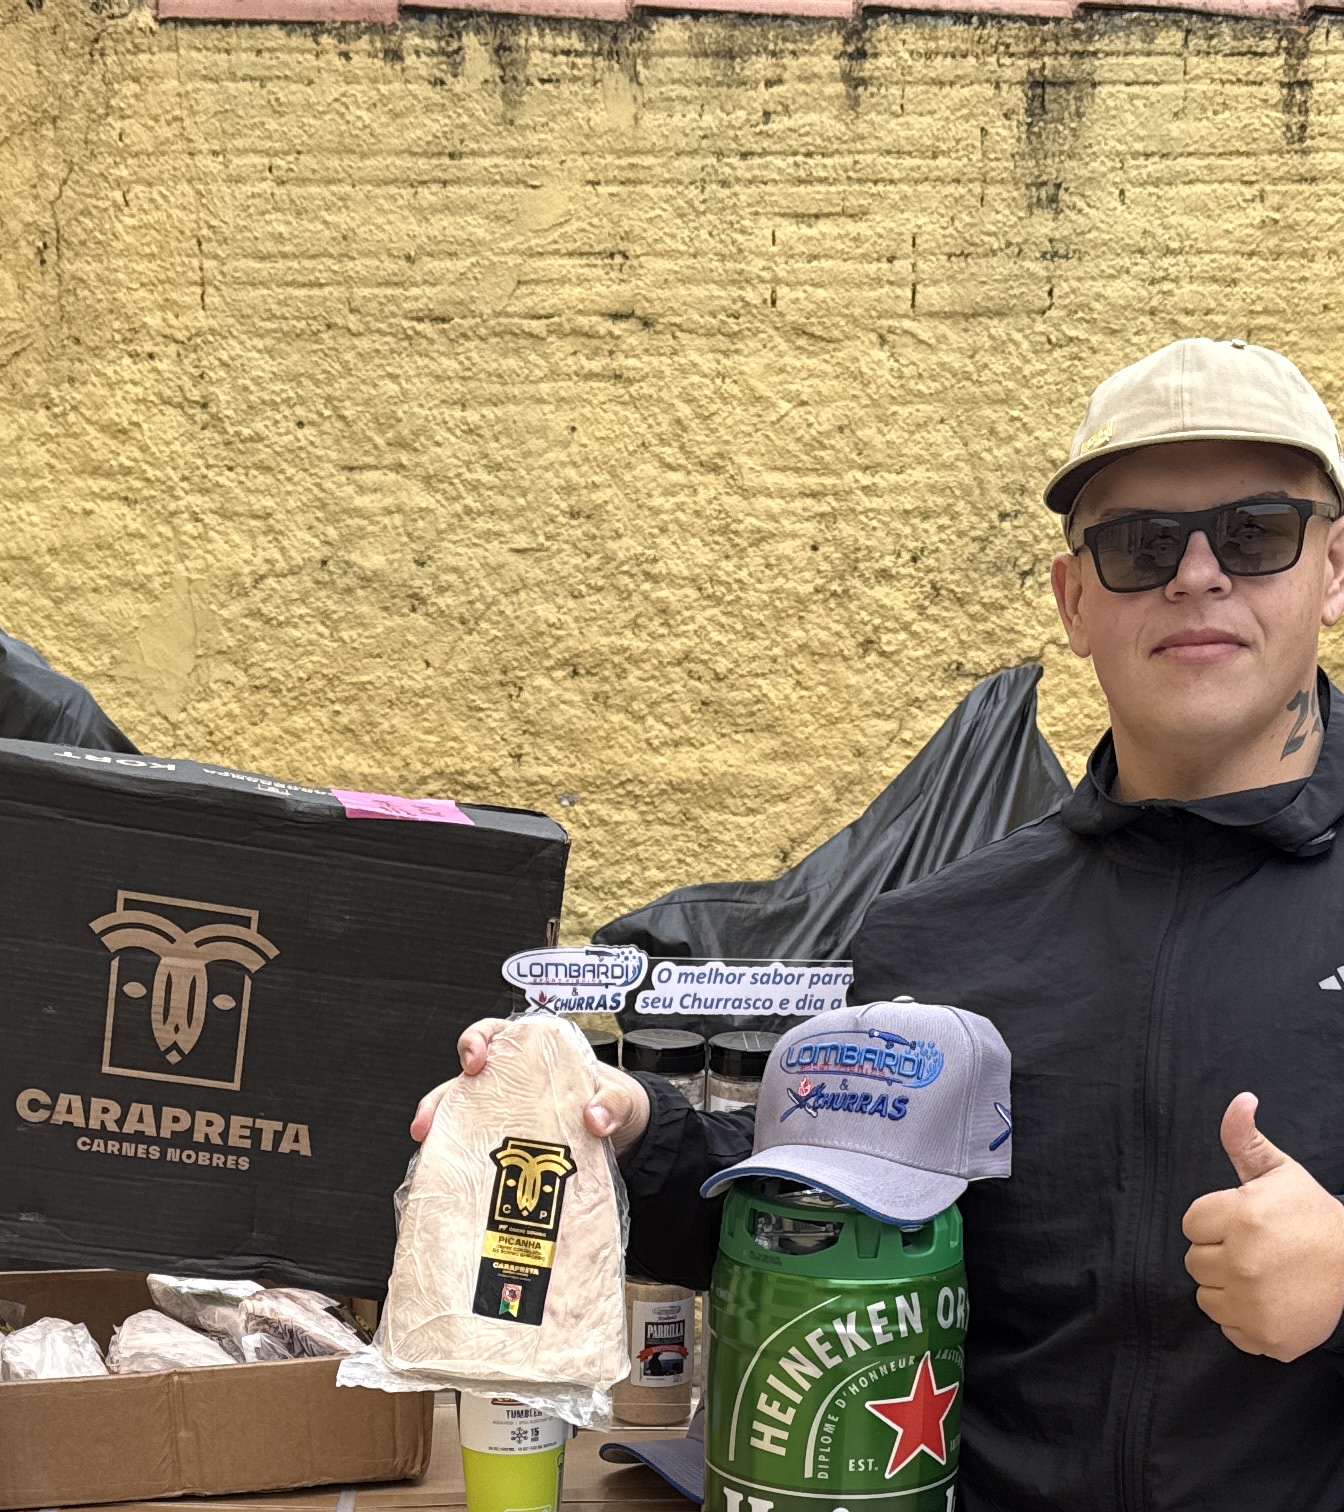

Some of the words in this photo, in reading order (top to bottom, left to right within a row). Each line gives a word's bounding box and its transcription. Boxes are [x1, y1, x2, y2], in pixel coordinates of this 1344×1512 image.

[516, 961, 635, 980] LOMBARDI
[657, 967, 672, 985] O
[677, 967, 746, 986] melhor
[750, 967, 805, 986] sabor
[809, 972, 853, 991] para
[555, 992, 622, 1012] CHURRAS
[641, 995, 674, 1011] seu
[679, 993, 773, 1011] Churrasco
[778, 998, 790, 1011] e
[795, 993, 822, 1011] dia
[787, 1042, 925, 1080] LOMBARDI
[813, 1090, 909, 1120] CHURRAS
[16, 1088, 312, 1157] CARAPRETA
[76, 1136, 160, 1160] CARNES
[166, 1148, 250, 1170] NOBRES
[498, 1235, 541, 1250] PICANHA
[750, 1292, 924, 1456] HEINEKEN
[817, 1413, 839, 1479] DIPLOME
[835, 1355, 916, 1409] D'HONNEUR
[848, 1458, 879, 1472] EST.
